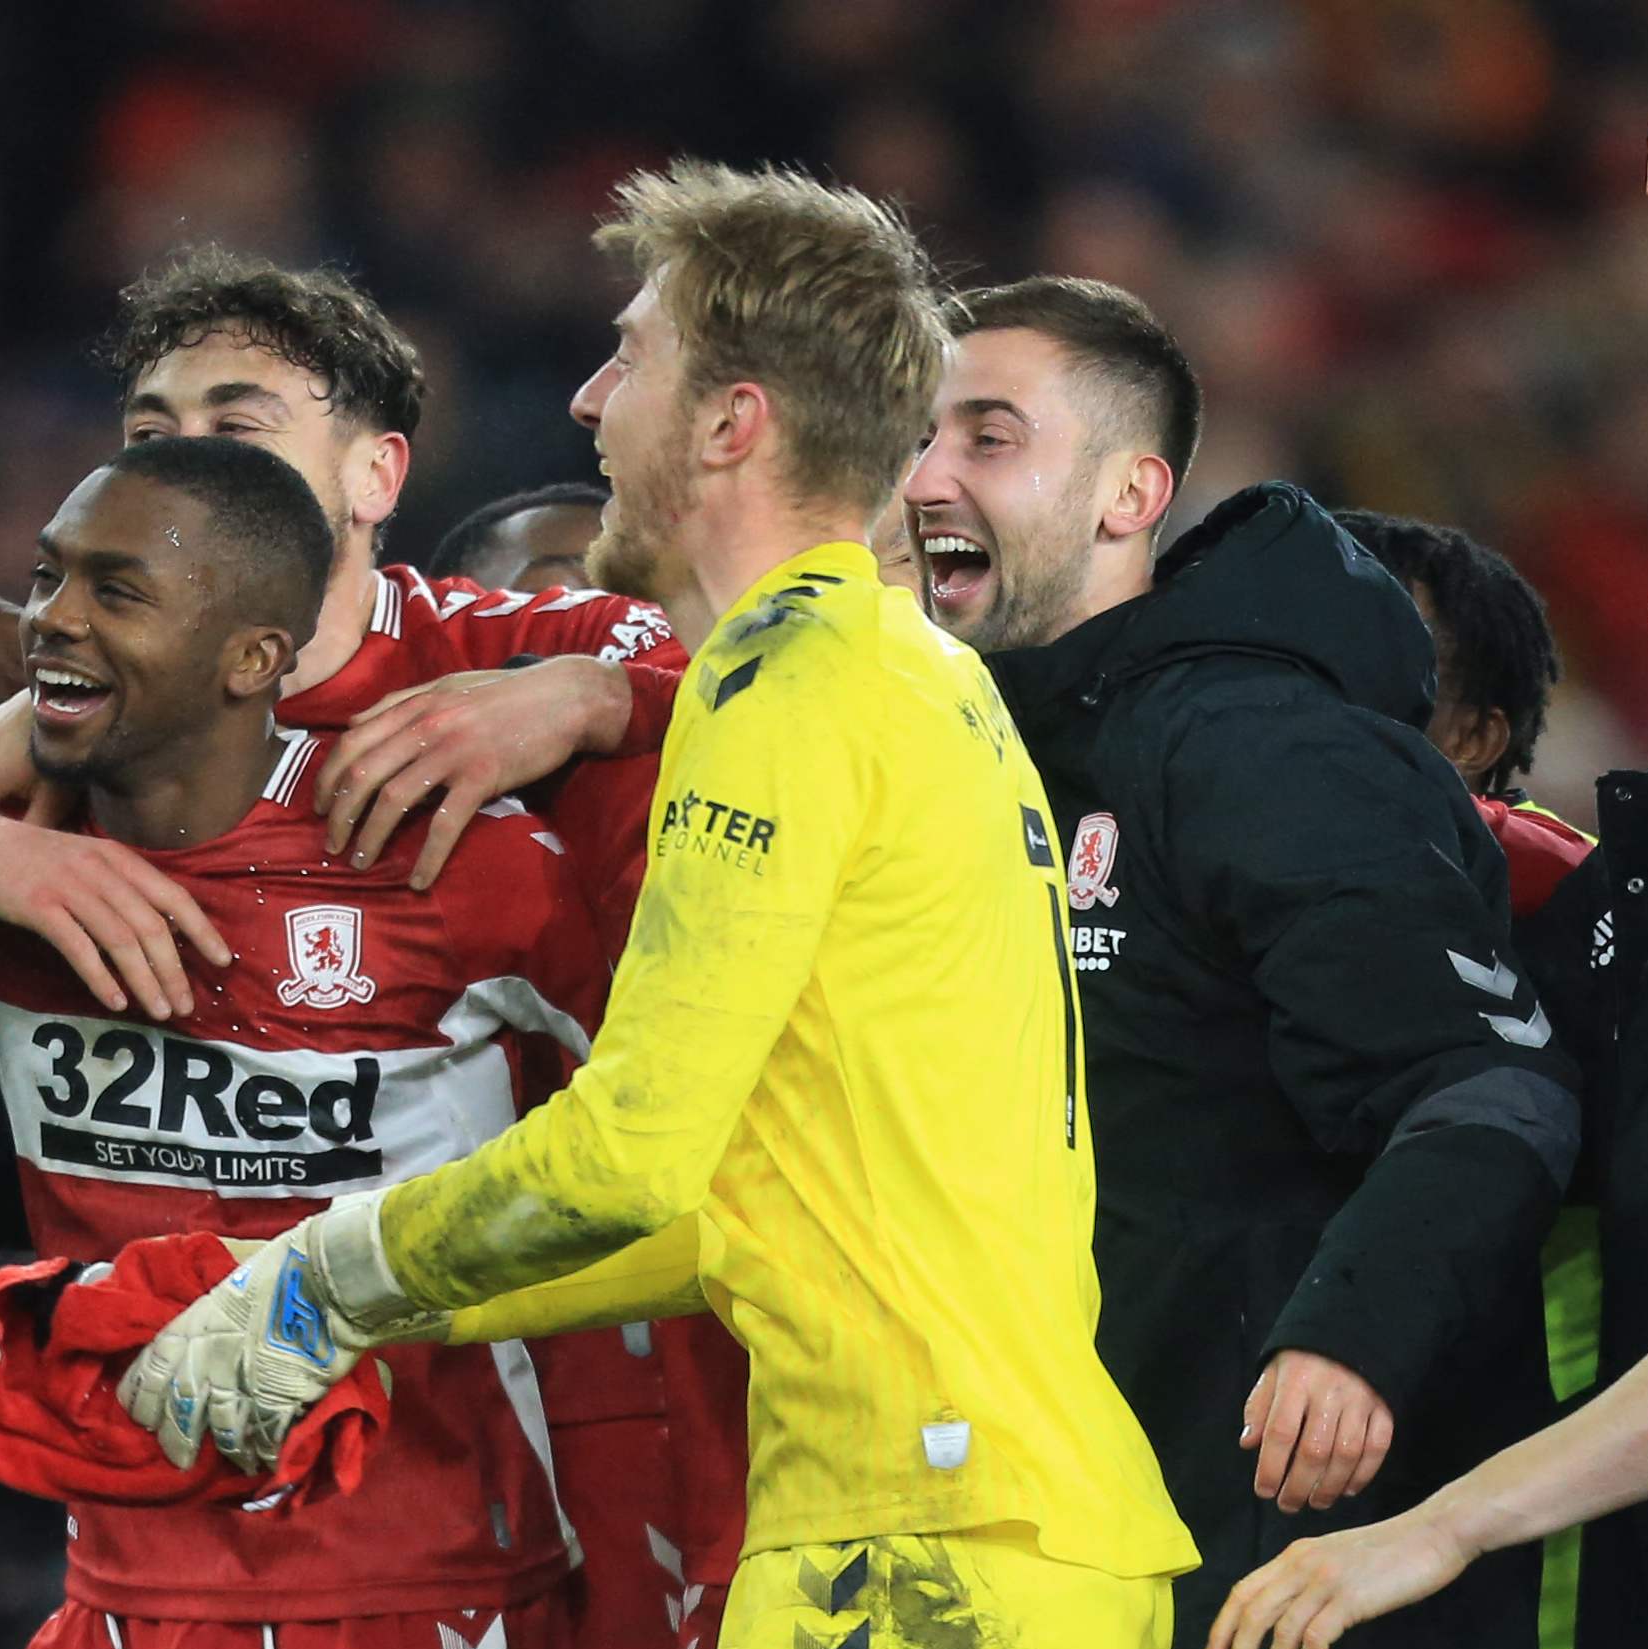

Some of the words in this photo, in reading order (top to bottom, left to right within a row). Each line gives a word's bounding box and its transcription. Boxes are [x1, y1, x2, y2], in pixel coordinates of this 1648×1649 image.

[661, 790, 775, 854] AXTER
[31, 1022, 381, 1144] 32Red
[94, 1141, 136, 1166] SET
[136, 1145, 207, 1176] YOUR
[215, 1156, 307, 1181] LIMITS
